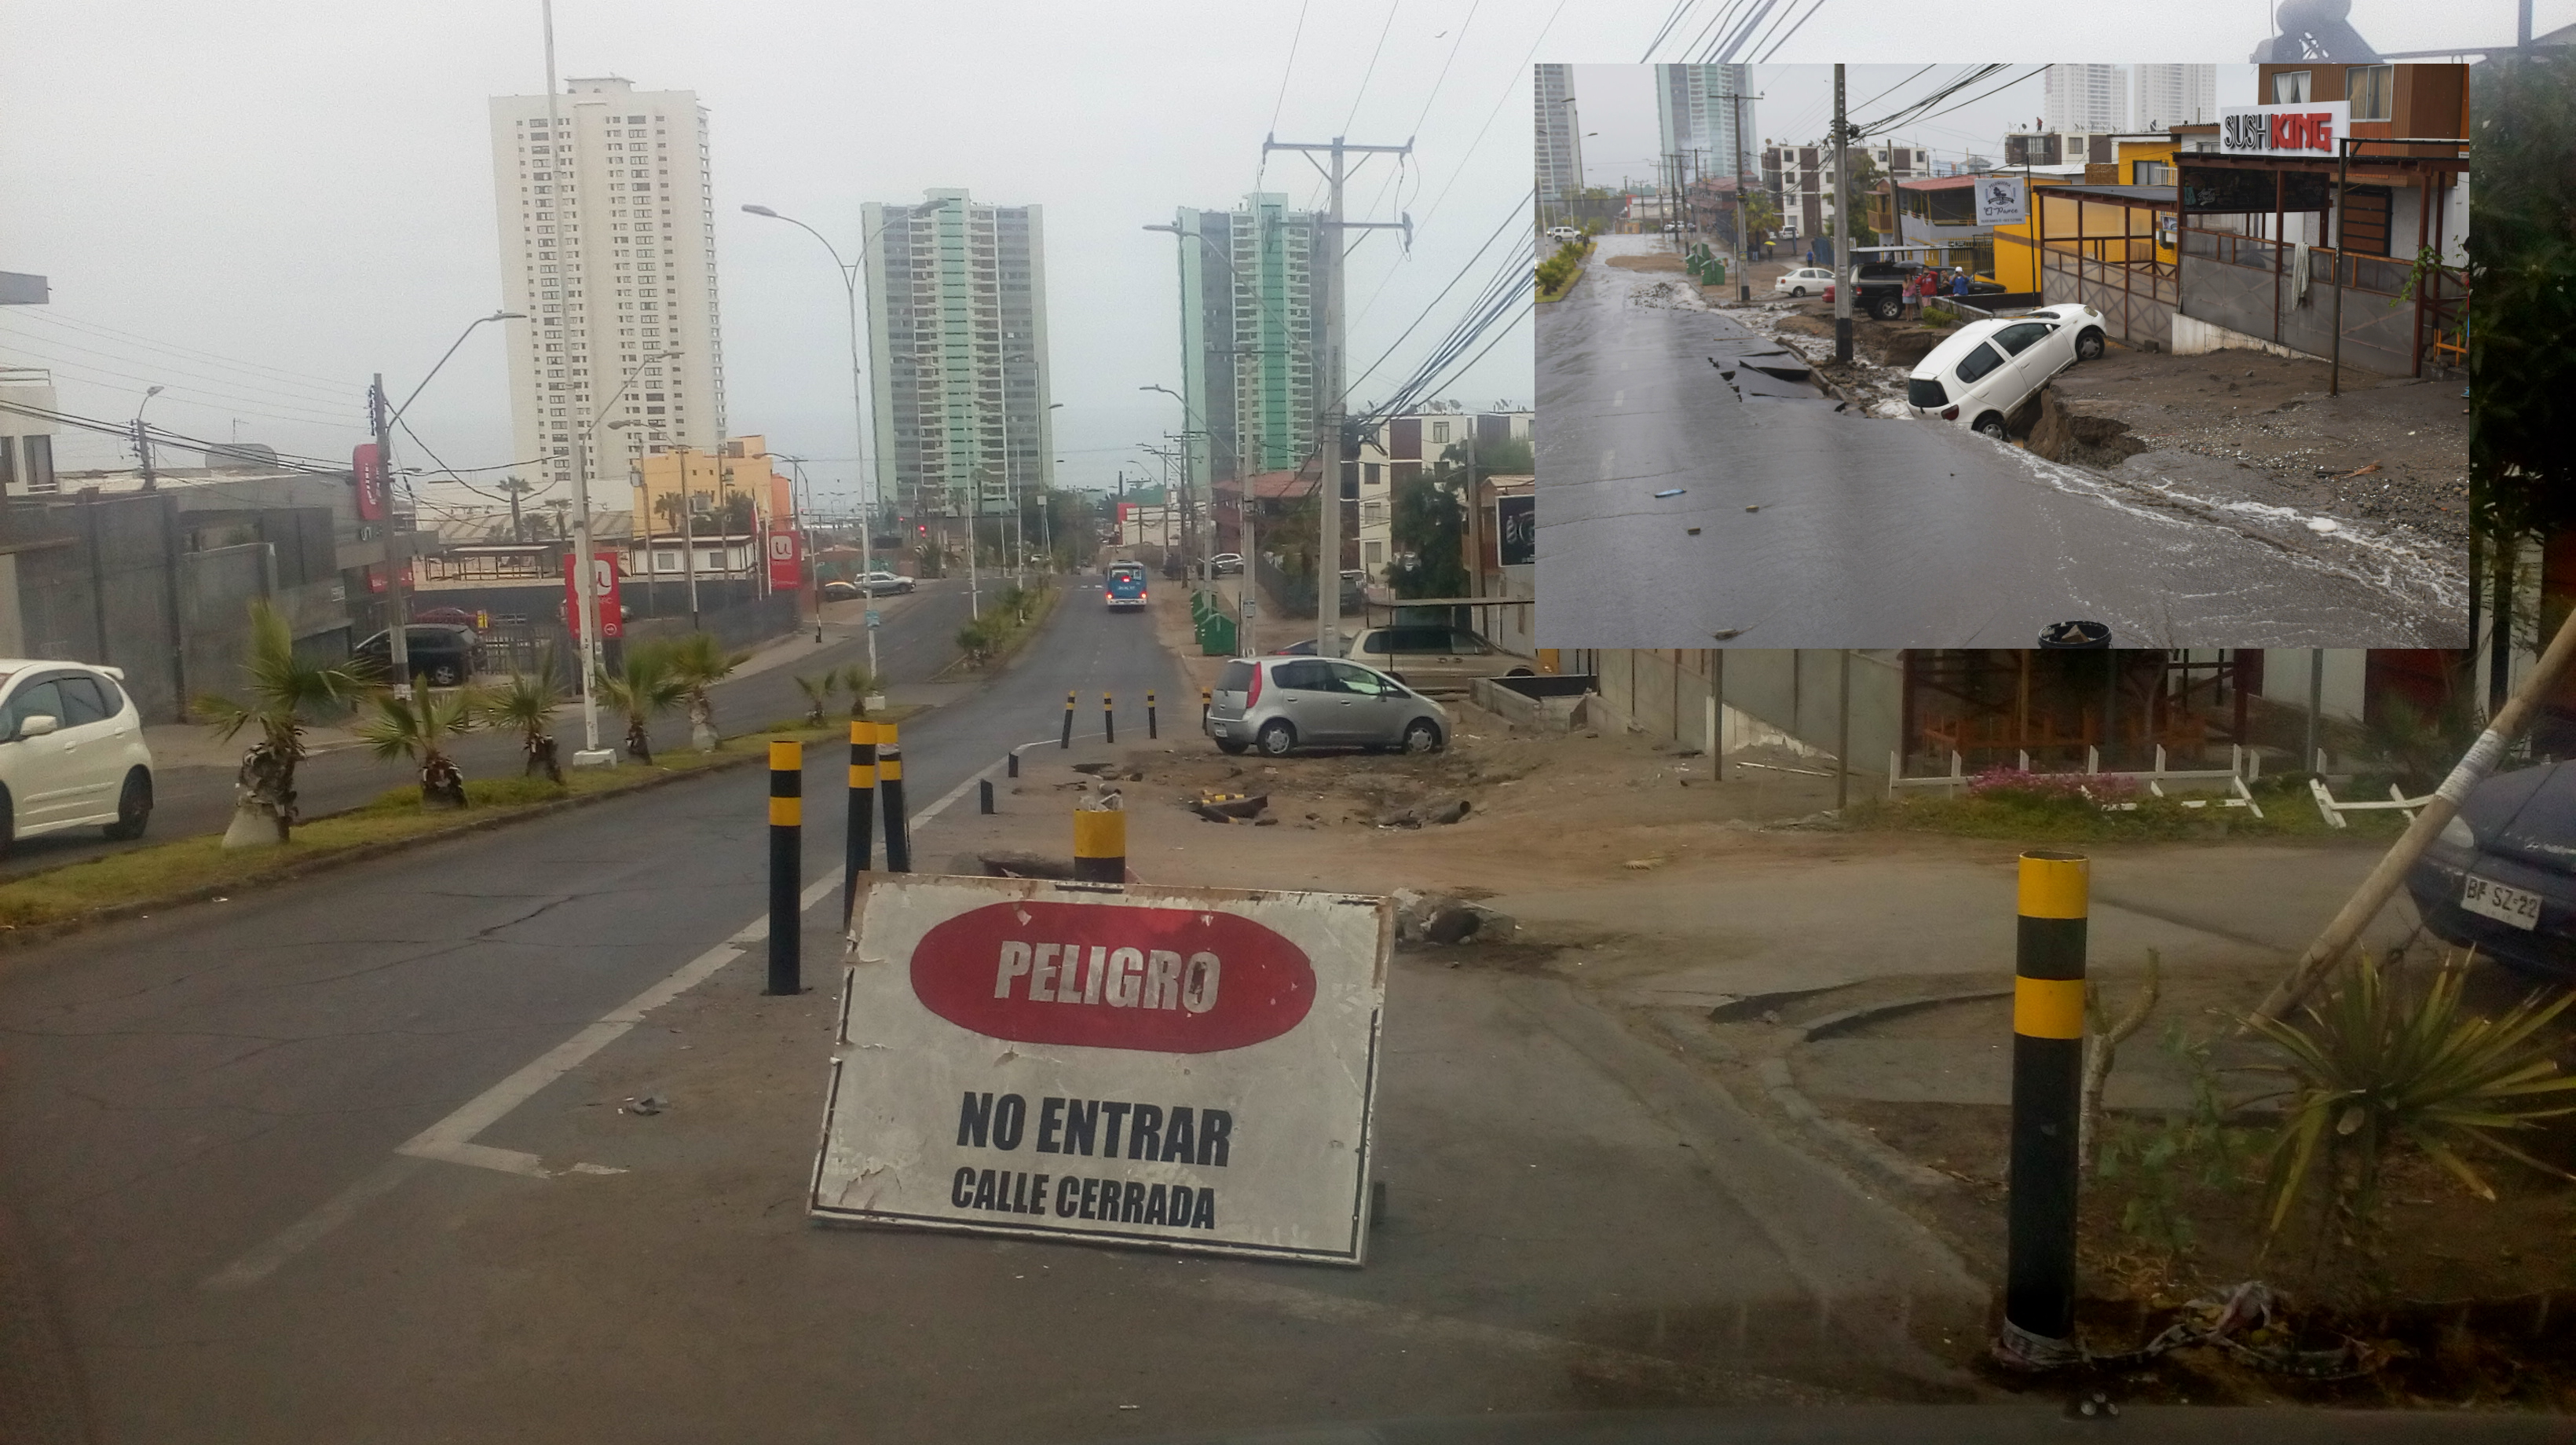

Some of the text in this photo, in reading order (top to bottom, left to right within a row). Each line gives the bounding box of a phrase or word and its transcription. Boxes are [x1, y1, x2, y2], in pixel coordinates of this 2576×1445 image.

[994, 940, 1221, 1013] PELIGRO
[957, 1091, 1233, 1167] NO ENTRAR
[951, 1166, 1215, 1230] CALLE CERRADA
